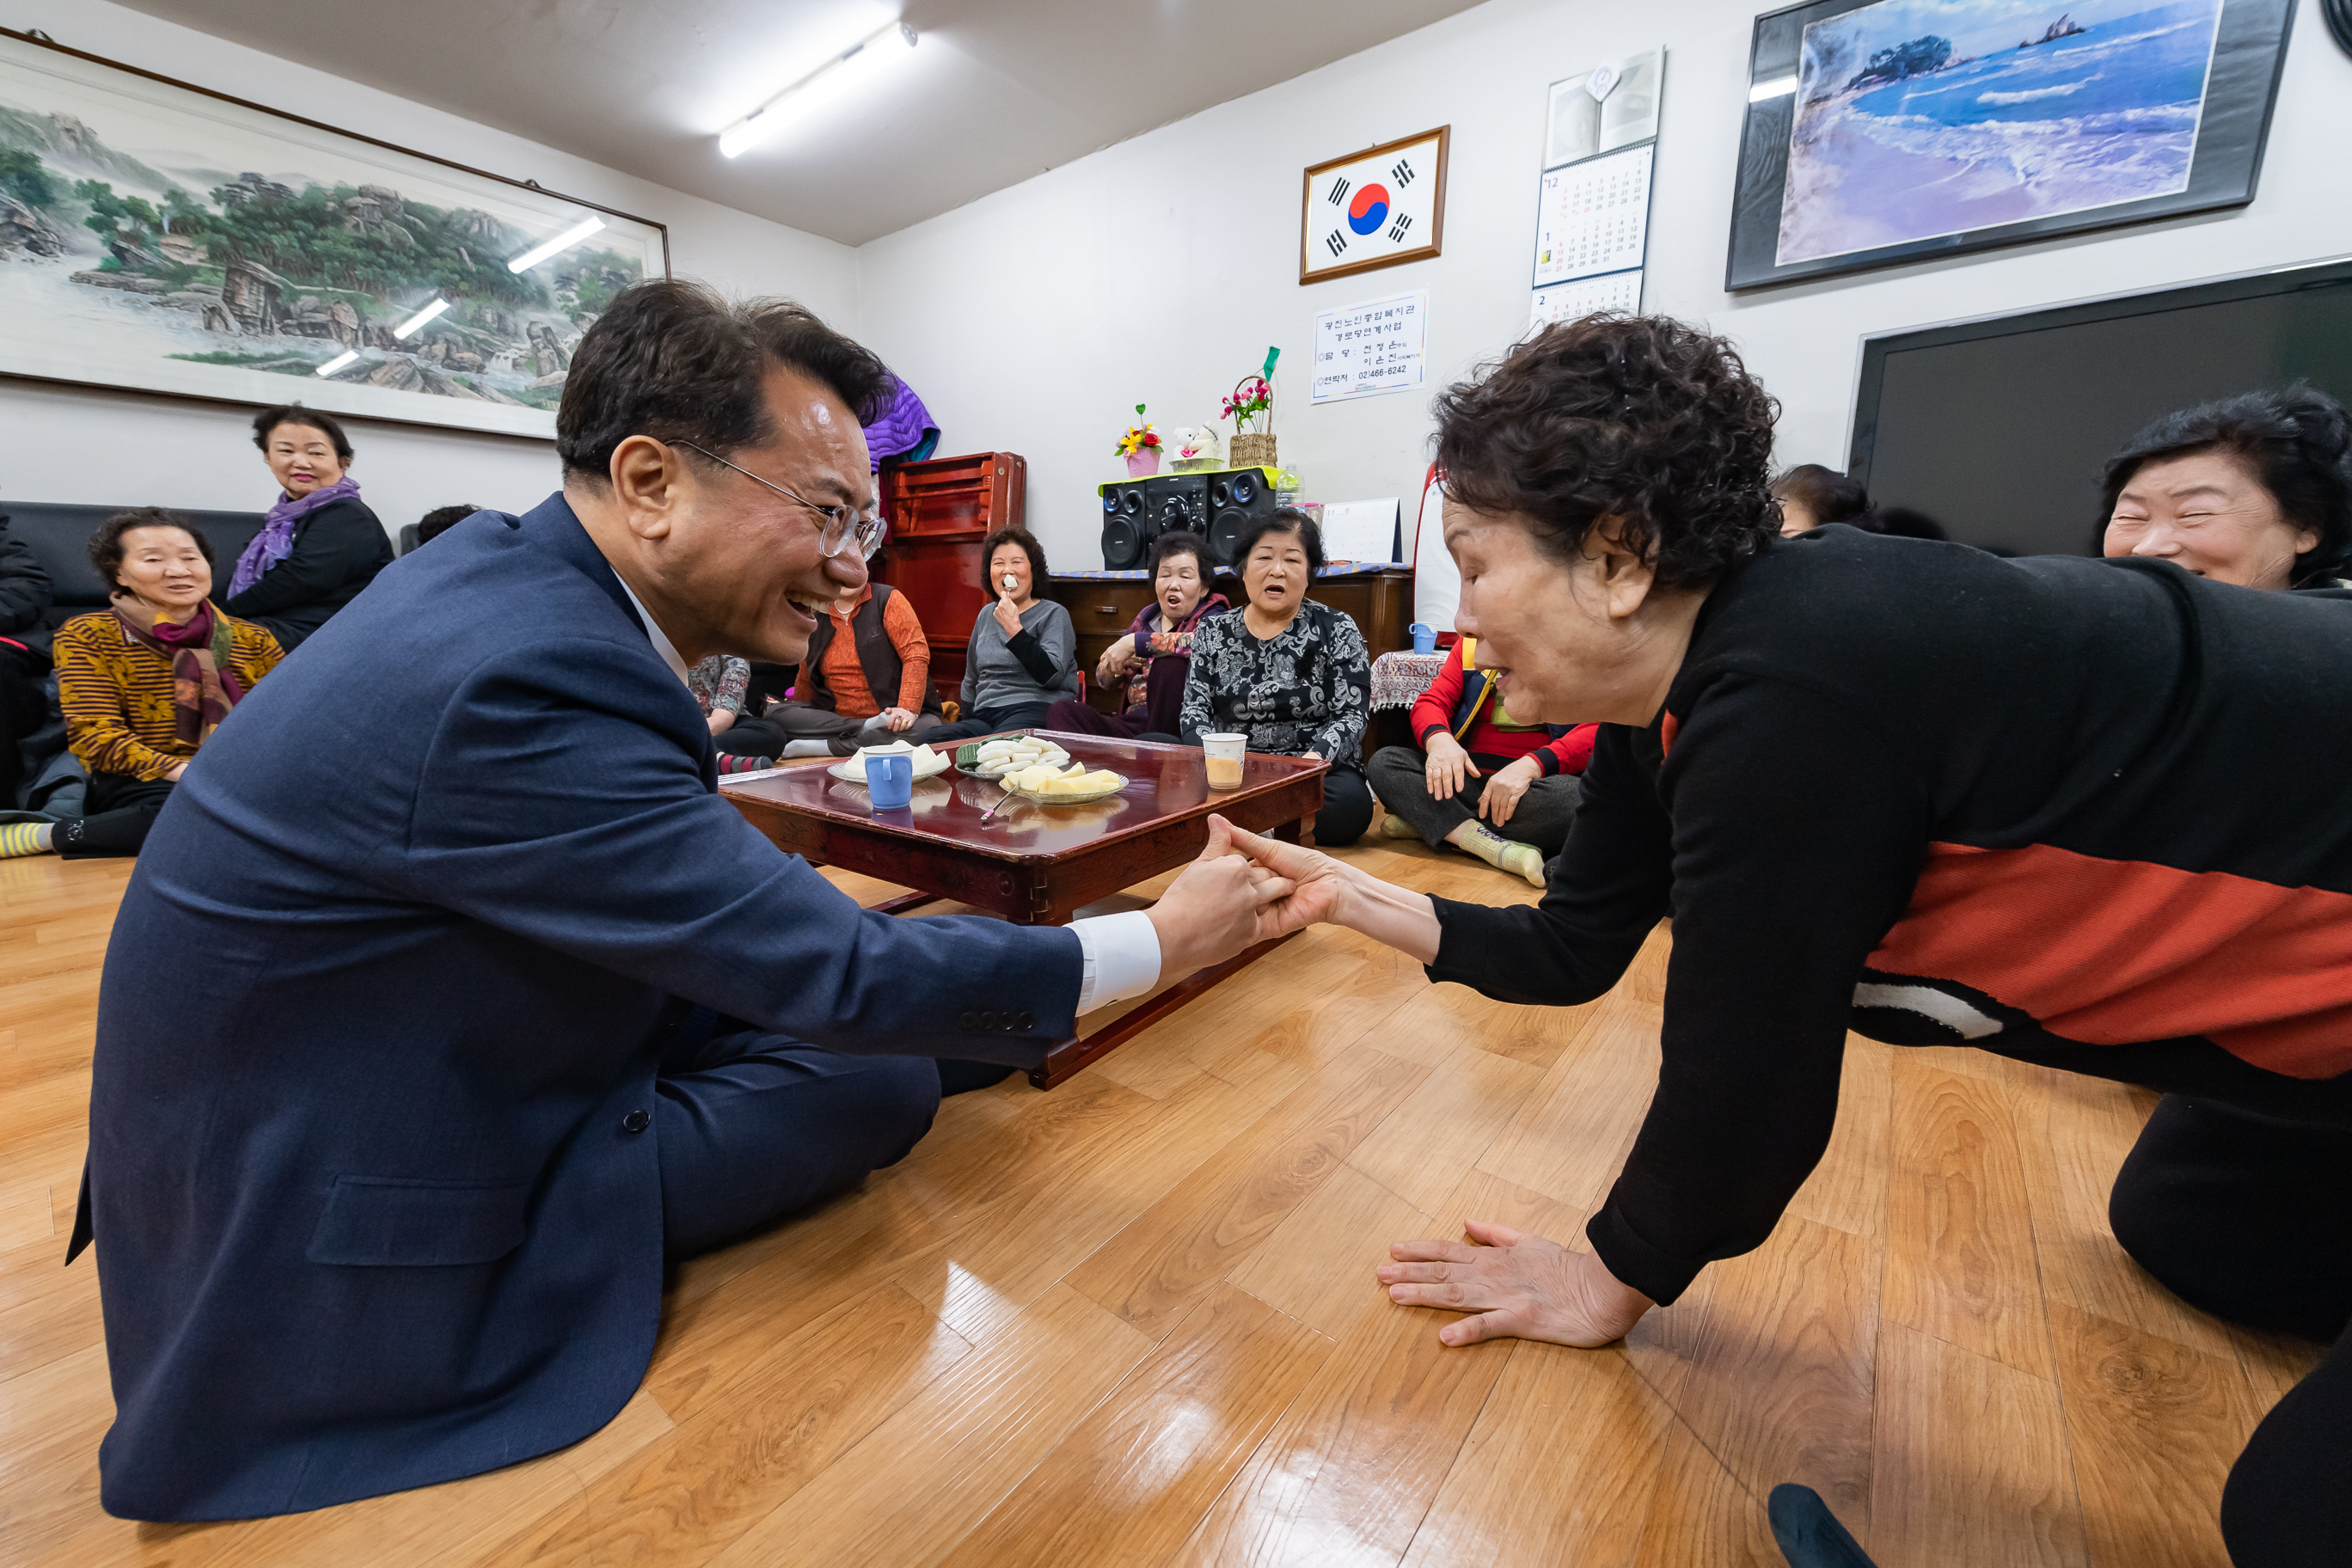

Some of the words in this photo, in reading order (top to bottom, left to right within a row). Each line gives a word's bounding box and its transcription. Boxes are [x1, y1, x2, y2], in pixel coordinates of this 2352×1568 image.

[1547, 178, 1558, 189] 12
[1546, 232, 1550, 241] 1
[1539, 296, 1545, 305] 2
[1359, 365, 1406, 379] 02)466-6242
